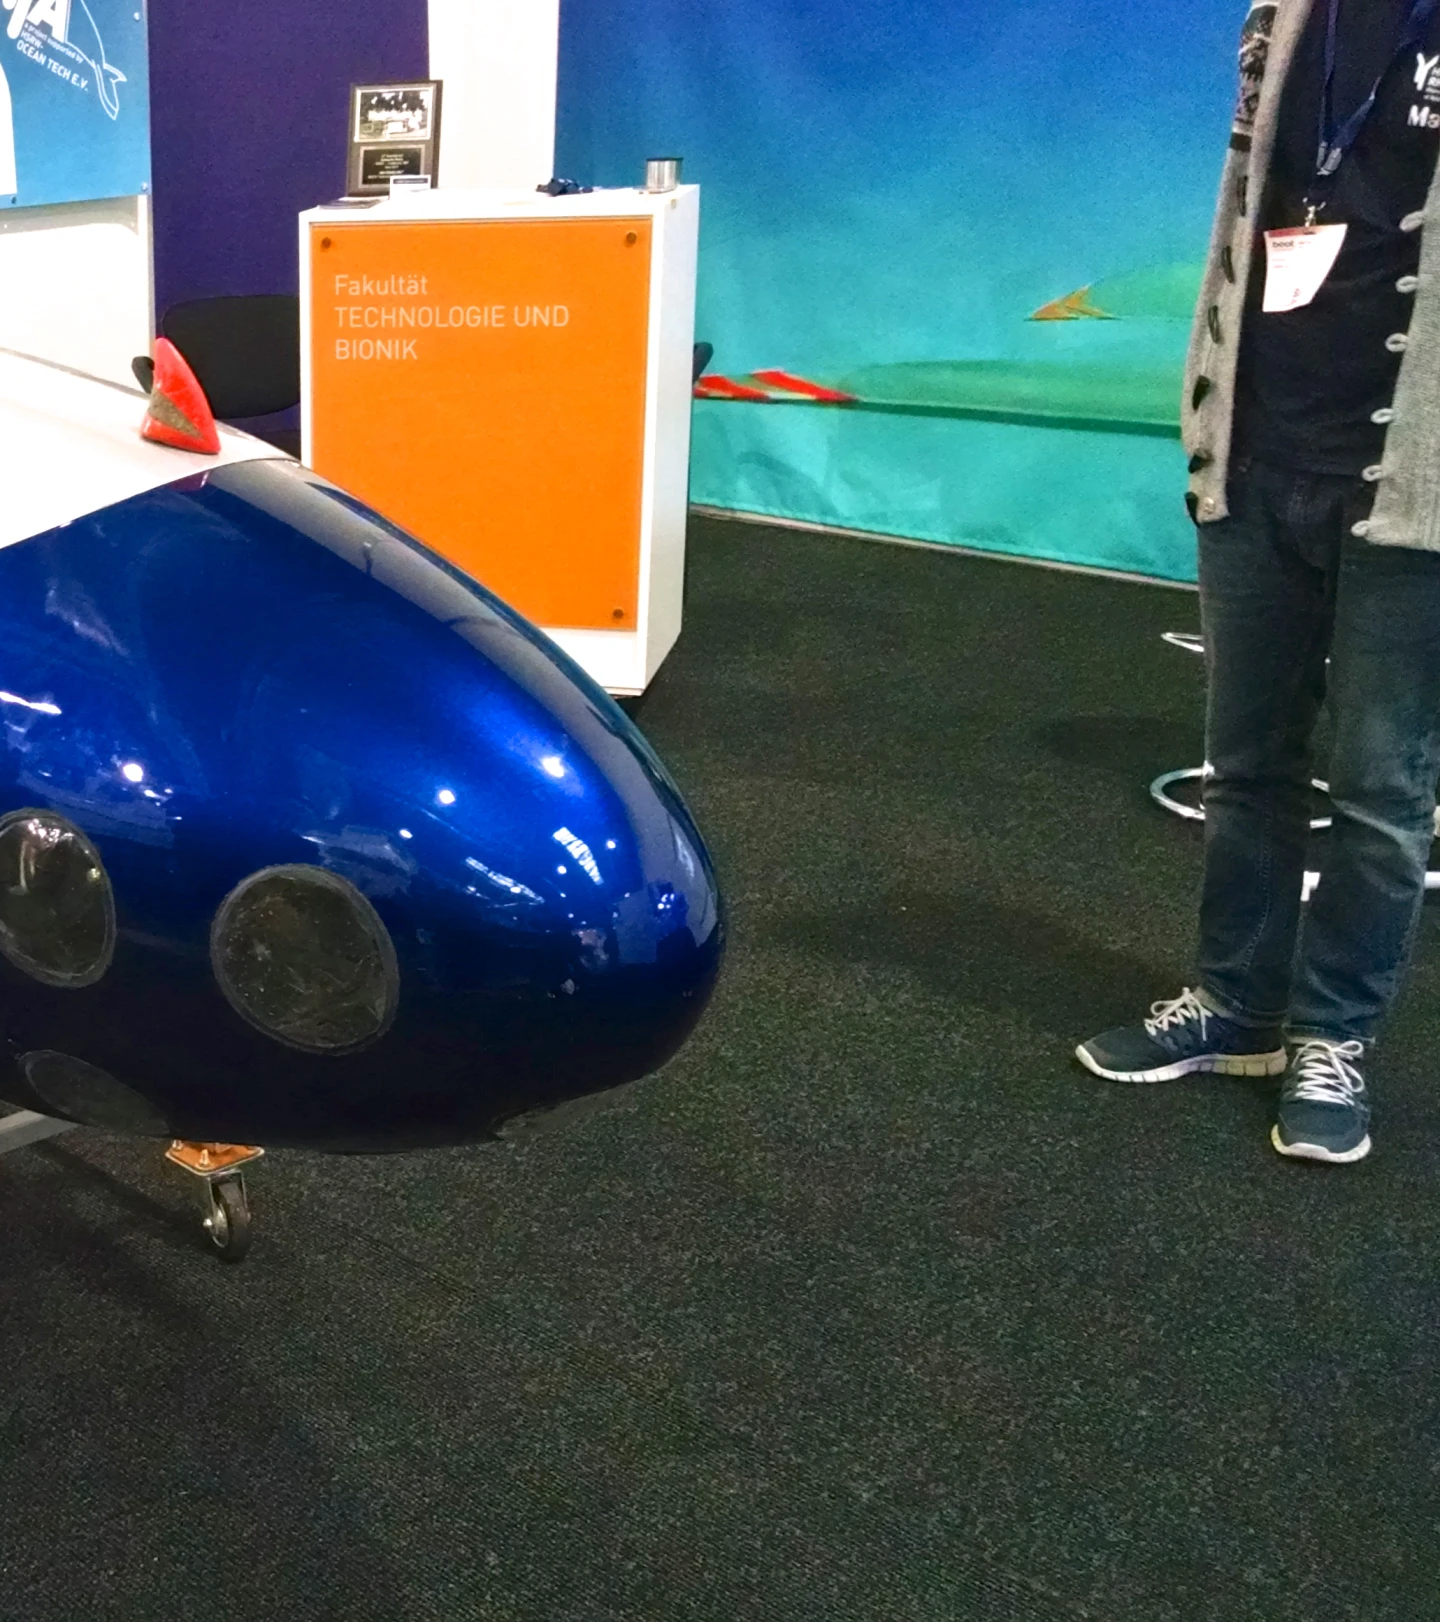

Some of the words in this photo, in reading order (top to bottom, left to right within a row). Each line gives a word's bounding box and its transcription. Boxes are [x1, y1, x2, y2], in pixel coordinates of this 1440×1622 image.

[16, 39, 46, 65] OCEAN
[47, 58, 71, 80] TECH
[70, 73, 88, 92] E.V.
[335, 274, 428, 296] Fakultät
[334, 306, 505, 328] TECHNOLOGIE
[513, 305, 569, 327] UND
[335, 339, 418, 360] BIONIK
